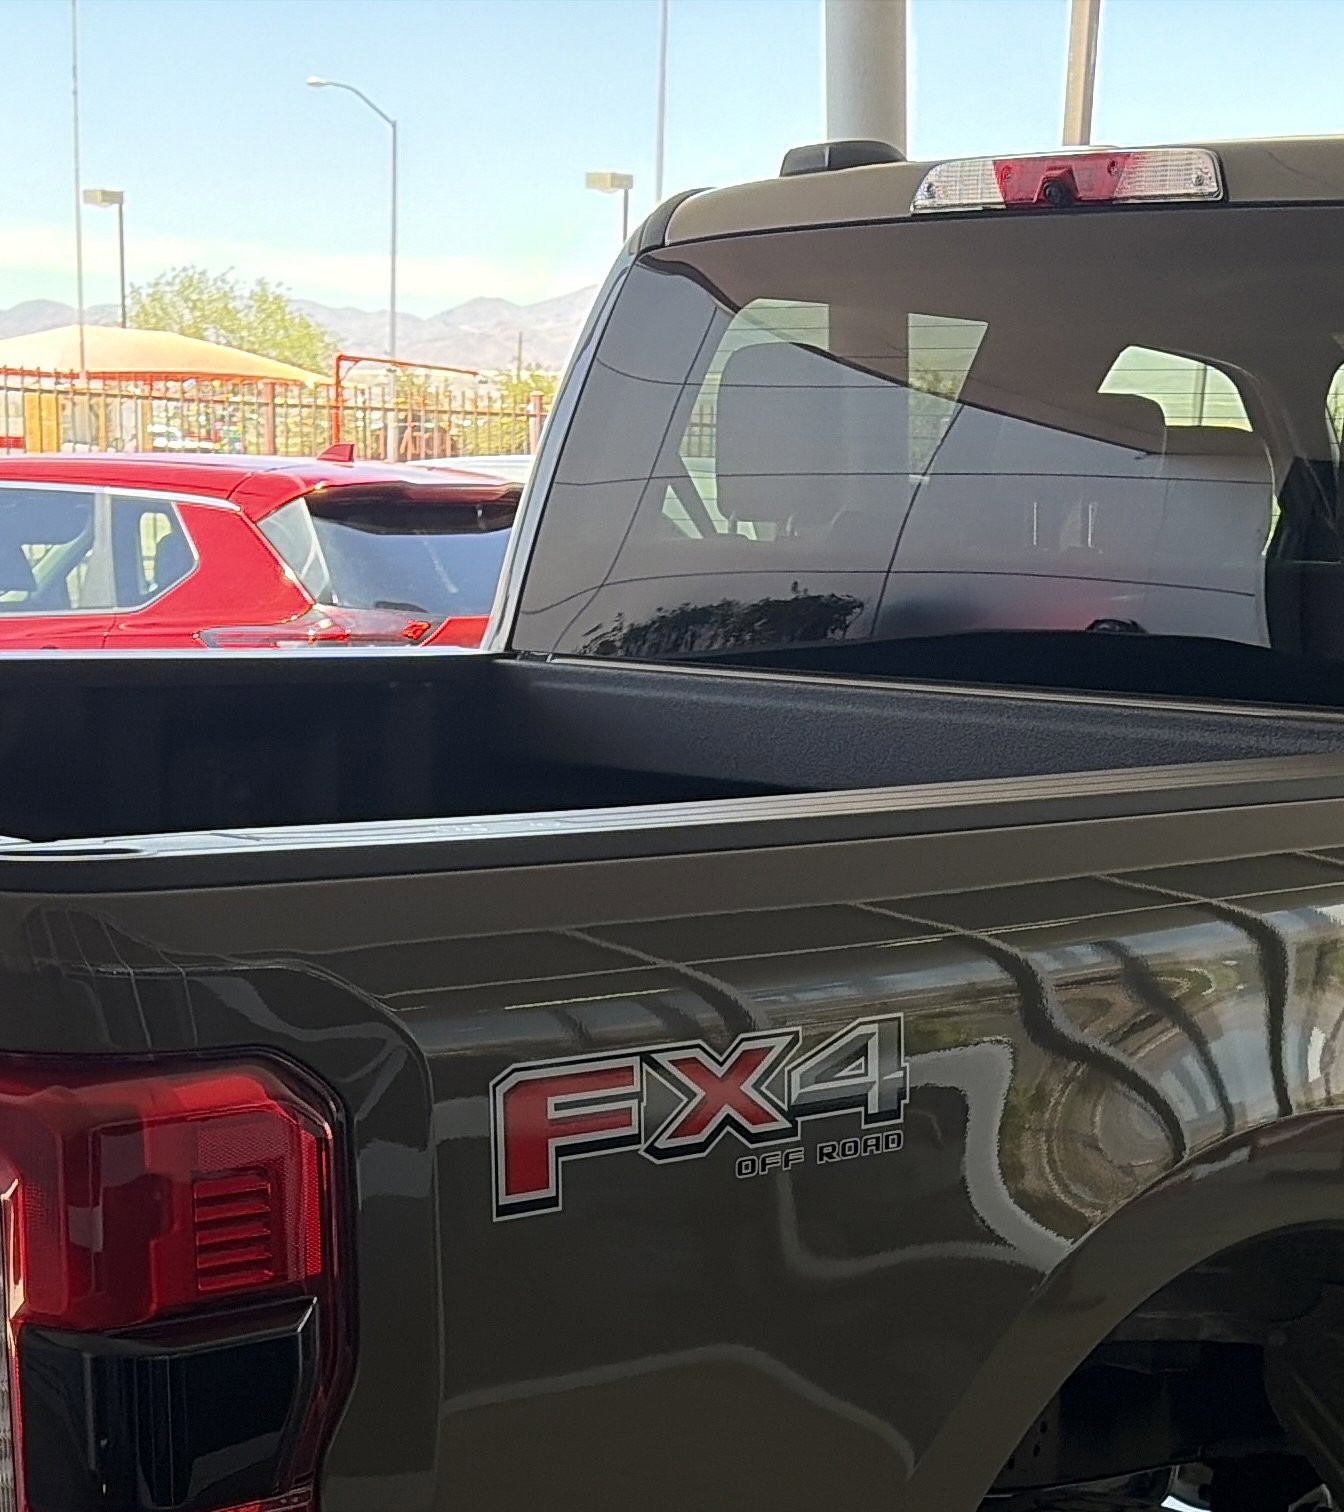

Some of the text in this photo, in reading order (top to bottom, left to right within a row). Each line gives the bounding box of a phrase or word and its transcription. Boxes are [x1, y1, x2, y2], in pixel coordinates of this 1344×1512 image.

[489, 1012, 909, 1223] FX4
[736, 1130, 903, 1179] OFF ROAD
